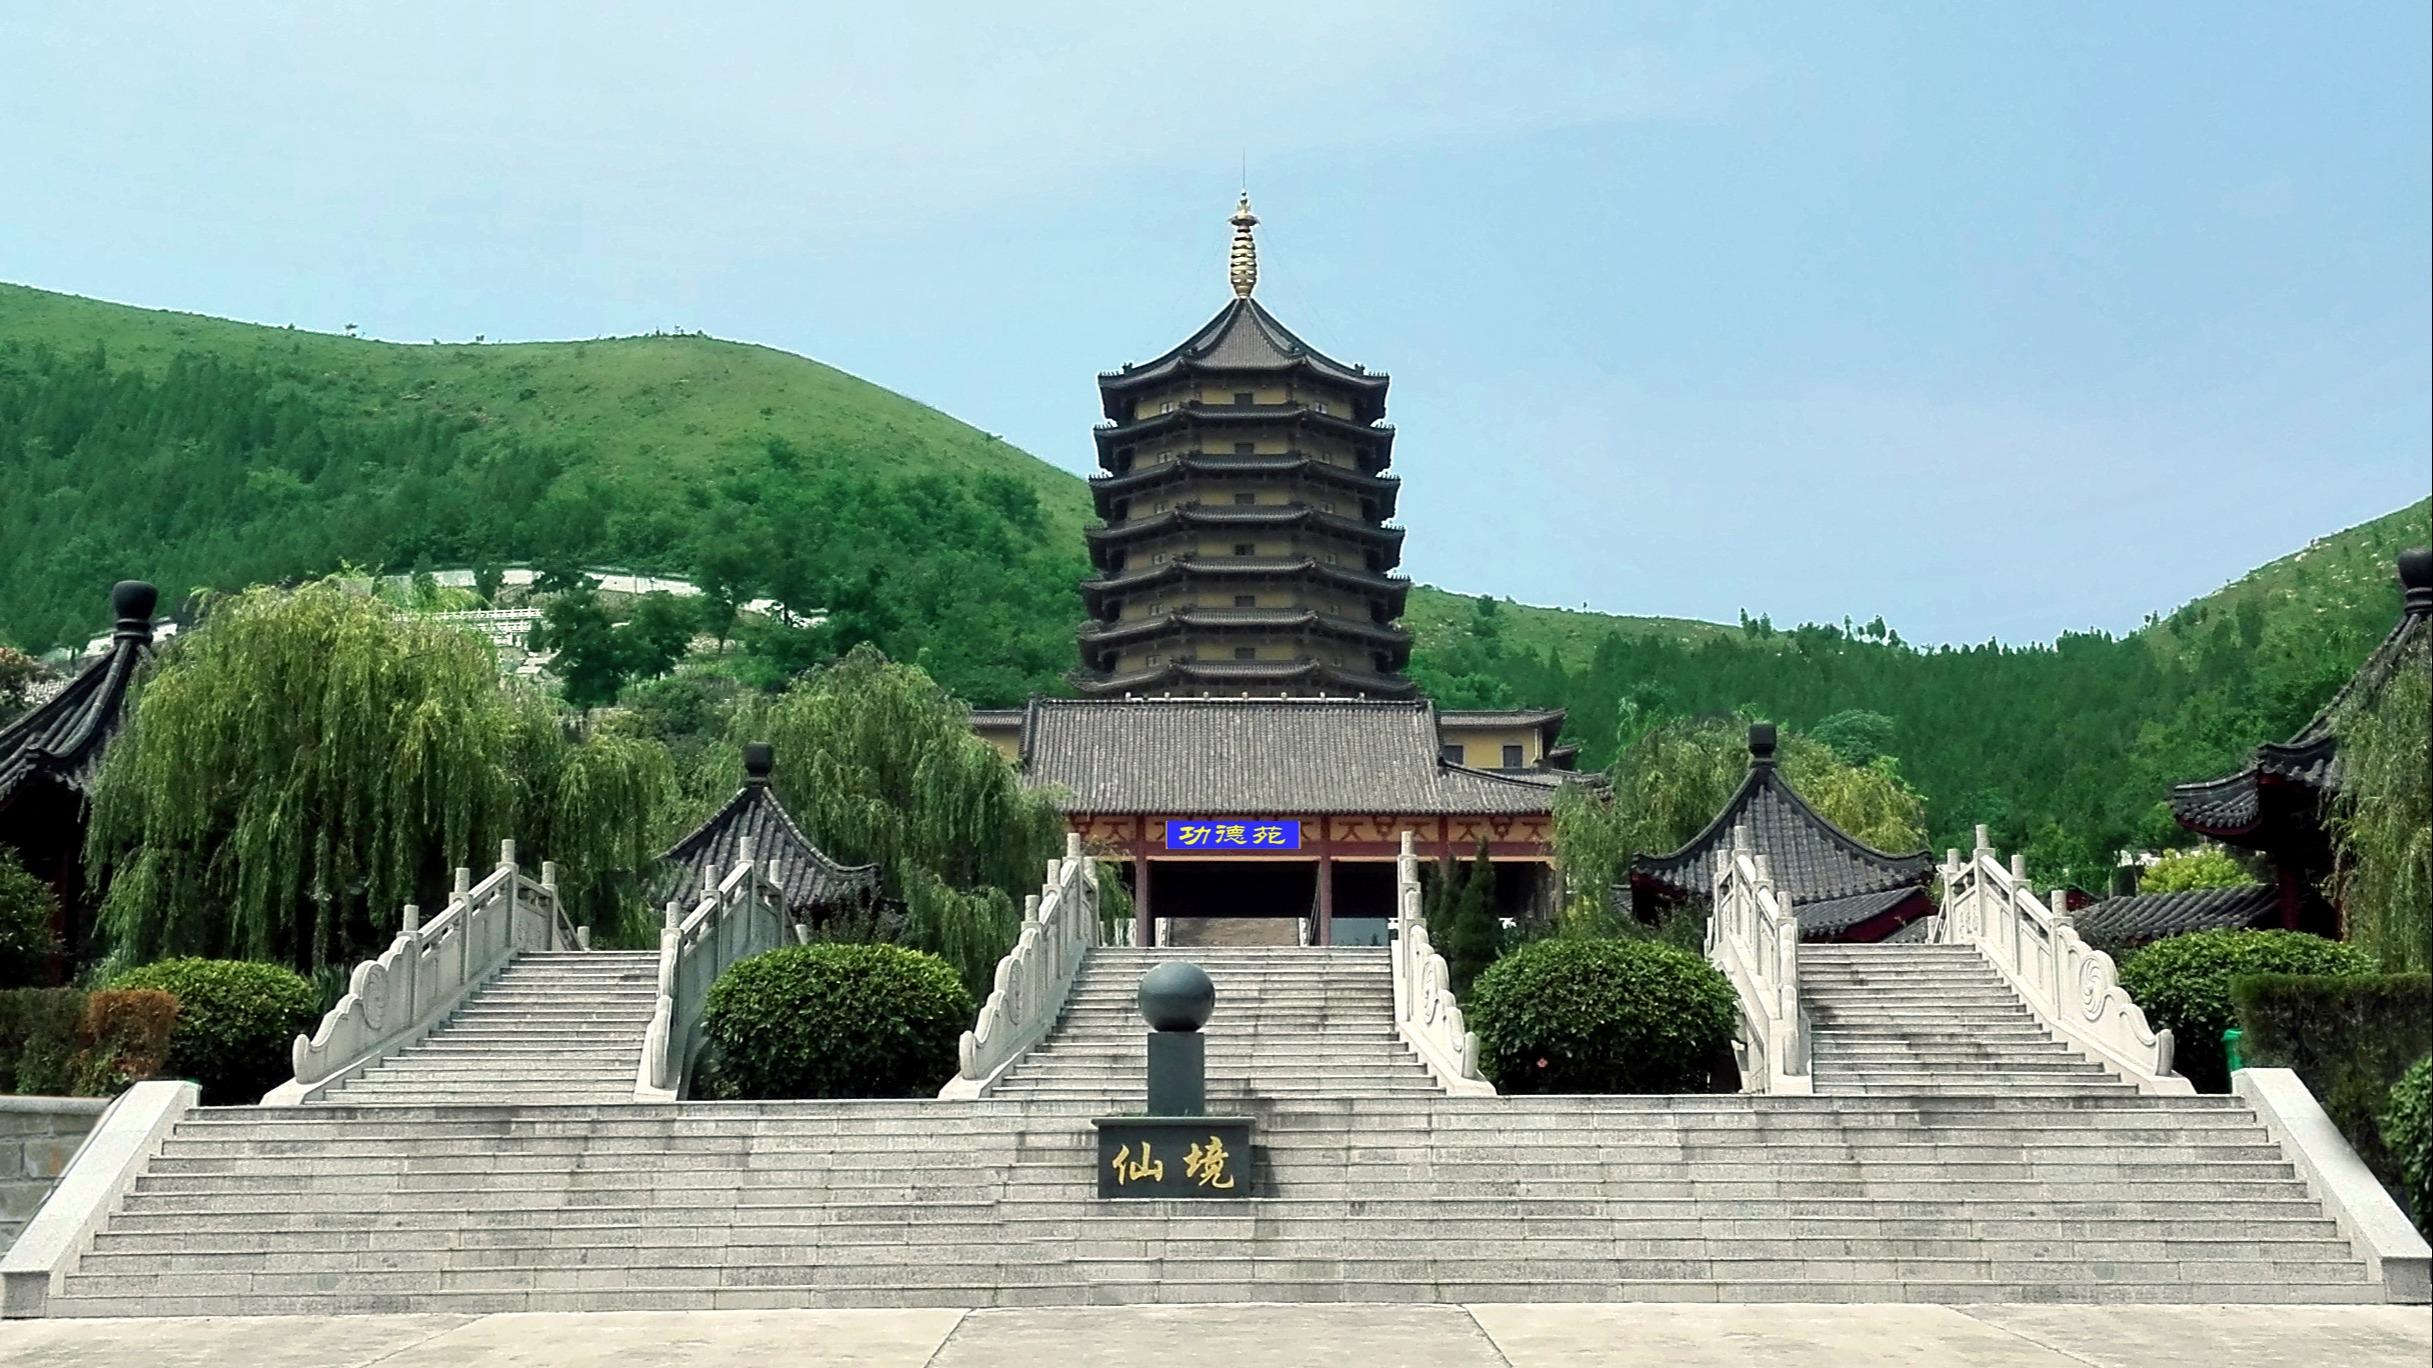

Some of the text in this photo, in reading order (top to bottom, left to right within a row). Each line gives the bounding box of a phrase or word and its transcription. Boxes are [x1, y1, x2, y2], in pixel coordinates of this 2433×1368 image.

[1179, 825, 1286, 845] 功德苑
[1112, 1136, 1234, 1188] 仙境
